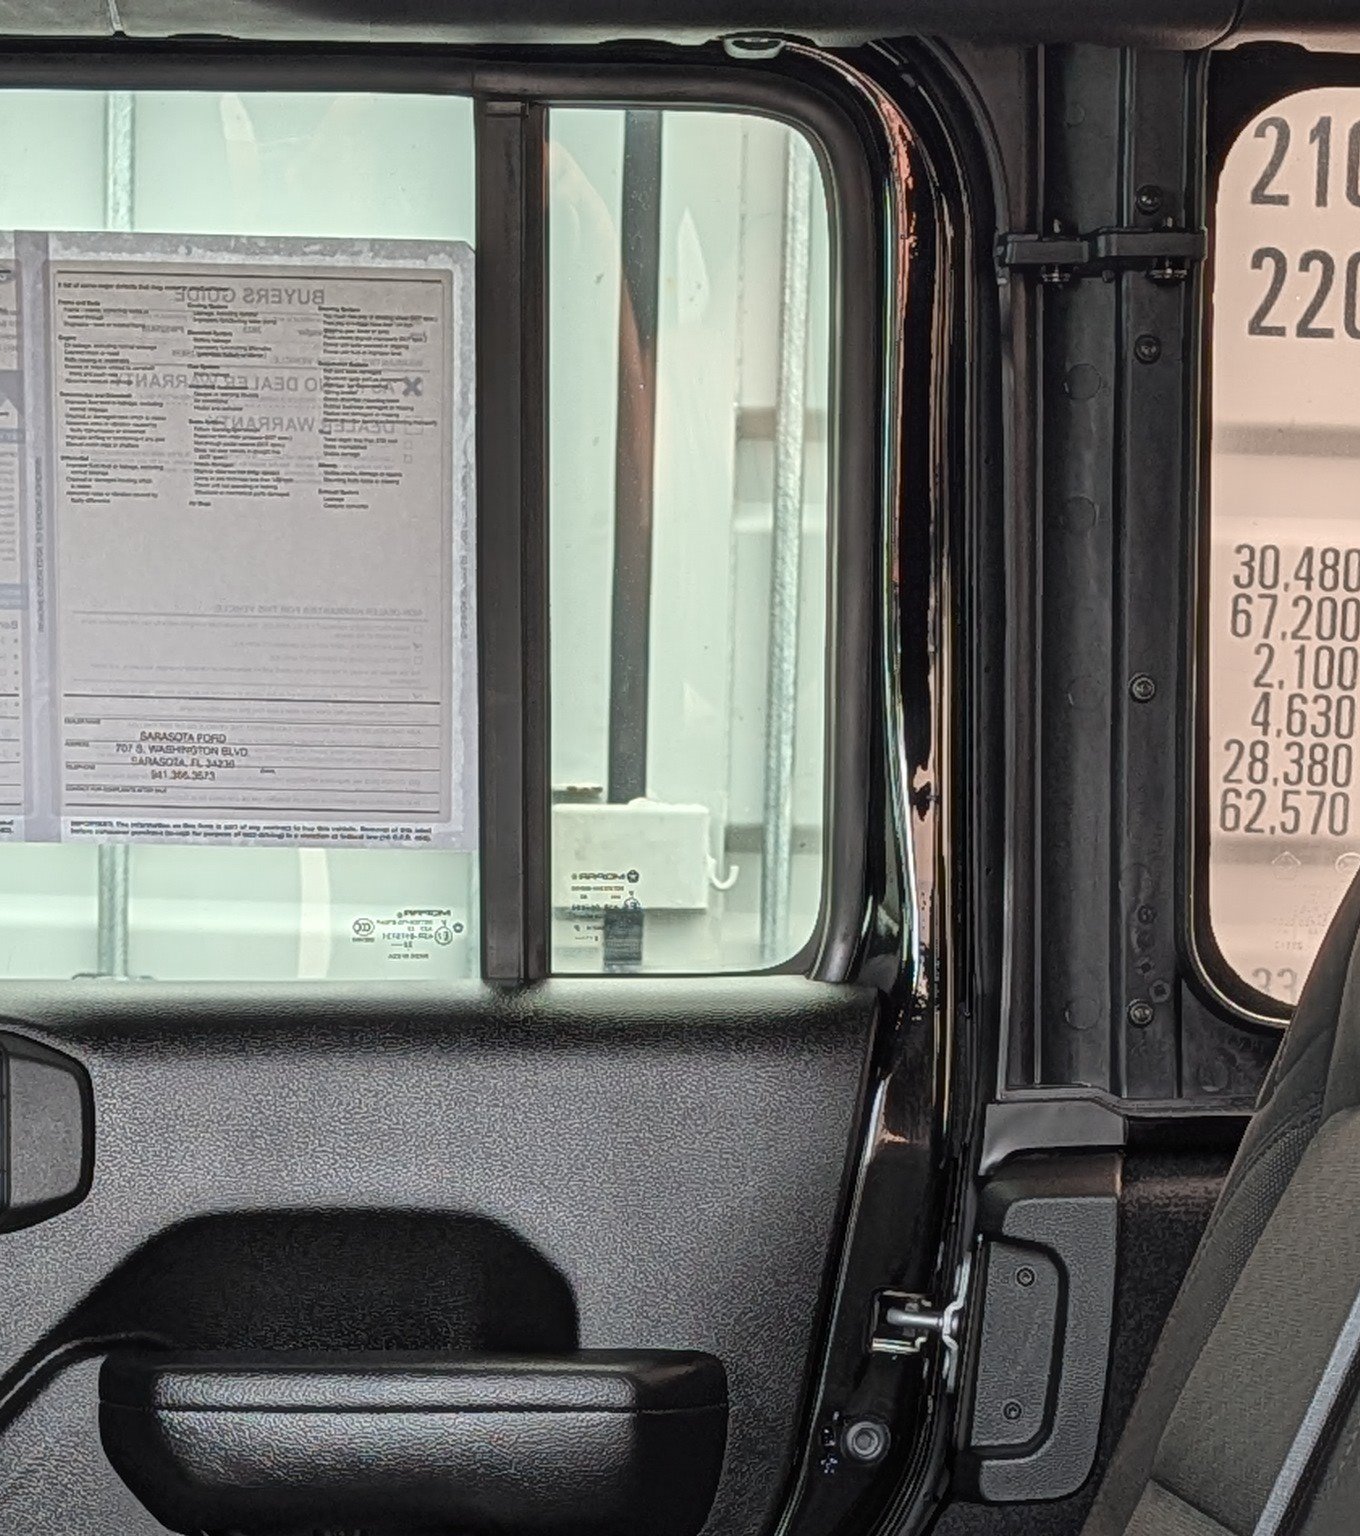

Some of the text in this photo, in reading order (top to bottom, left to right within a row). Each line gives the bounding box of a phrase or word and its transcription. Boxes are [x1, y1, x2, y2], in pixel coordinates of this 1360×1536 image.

[1253, 643, 1358, 691] 2,100
[139, 731, 227, 743] SARASOTA FORD
[1251, 691, 1356, 739] 4,630
[115, 743, 132, 753] 707
[148, 744, 219, 756] WASHINGTON
[1222, 740, 1353, 788] 28,380
[1219, 787, 1350, 836] 62,570
